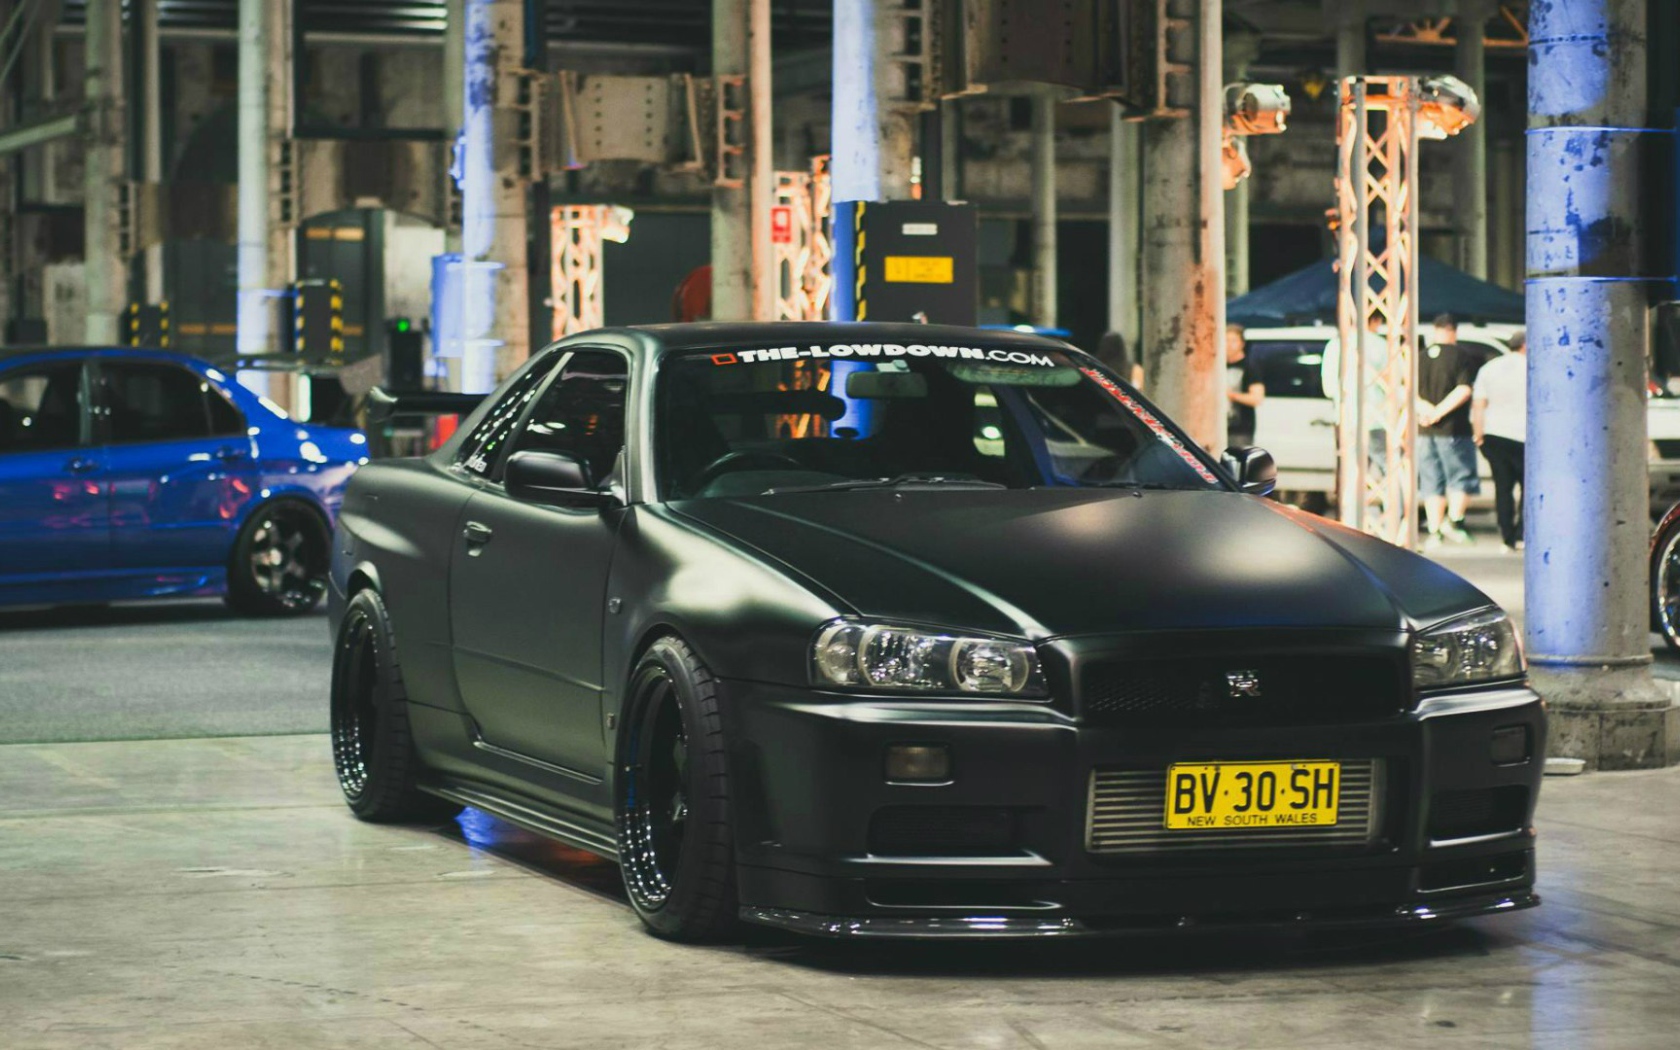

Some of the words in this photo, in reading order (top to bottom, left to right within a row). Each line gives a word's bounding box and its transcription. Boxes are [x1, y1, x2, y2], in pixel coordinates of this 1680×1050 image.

[738, 344, 1055, 367] THE-LOWDOWN.COM
[1187, 815, 1216, 827] NEW
[1224, 814, 1268, 826] SOUTH
[1275, 812, 1317, 824] WALES
